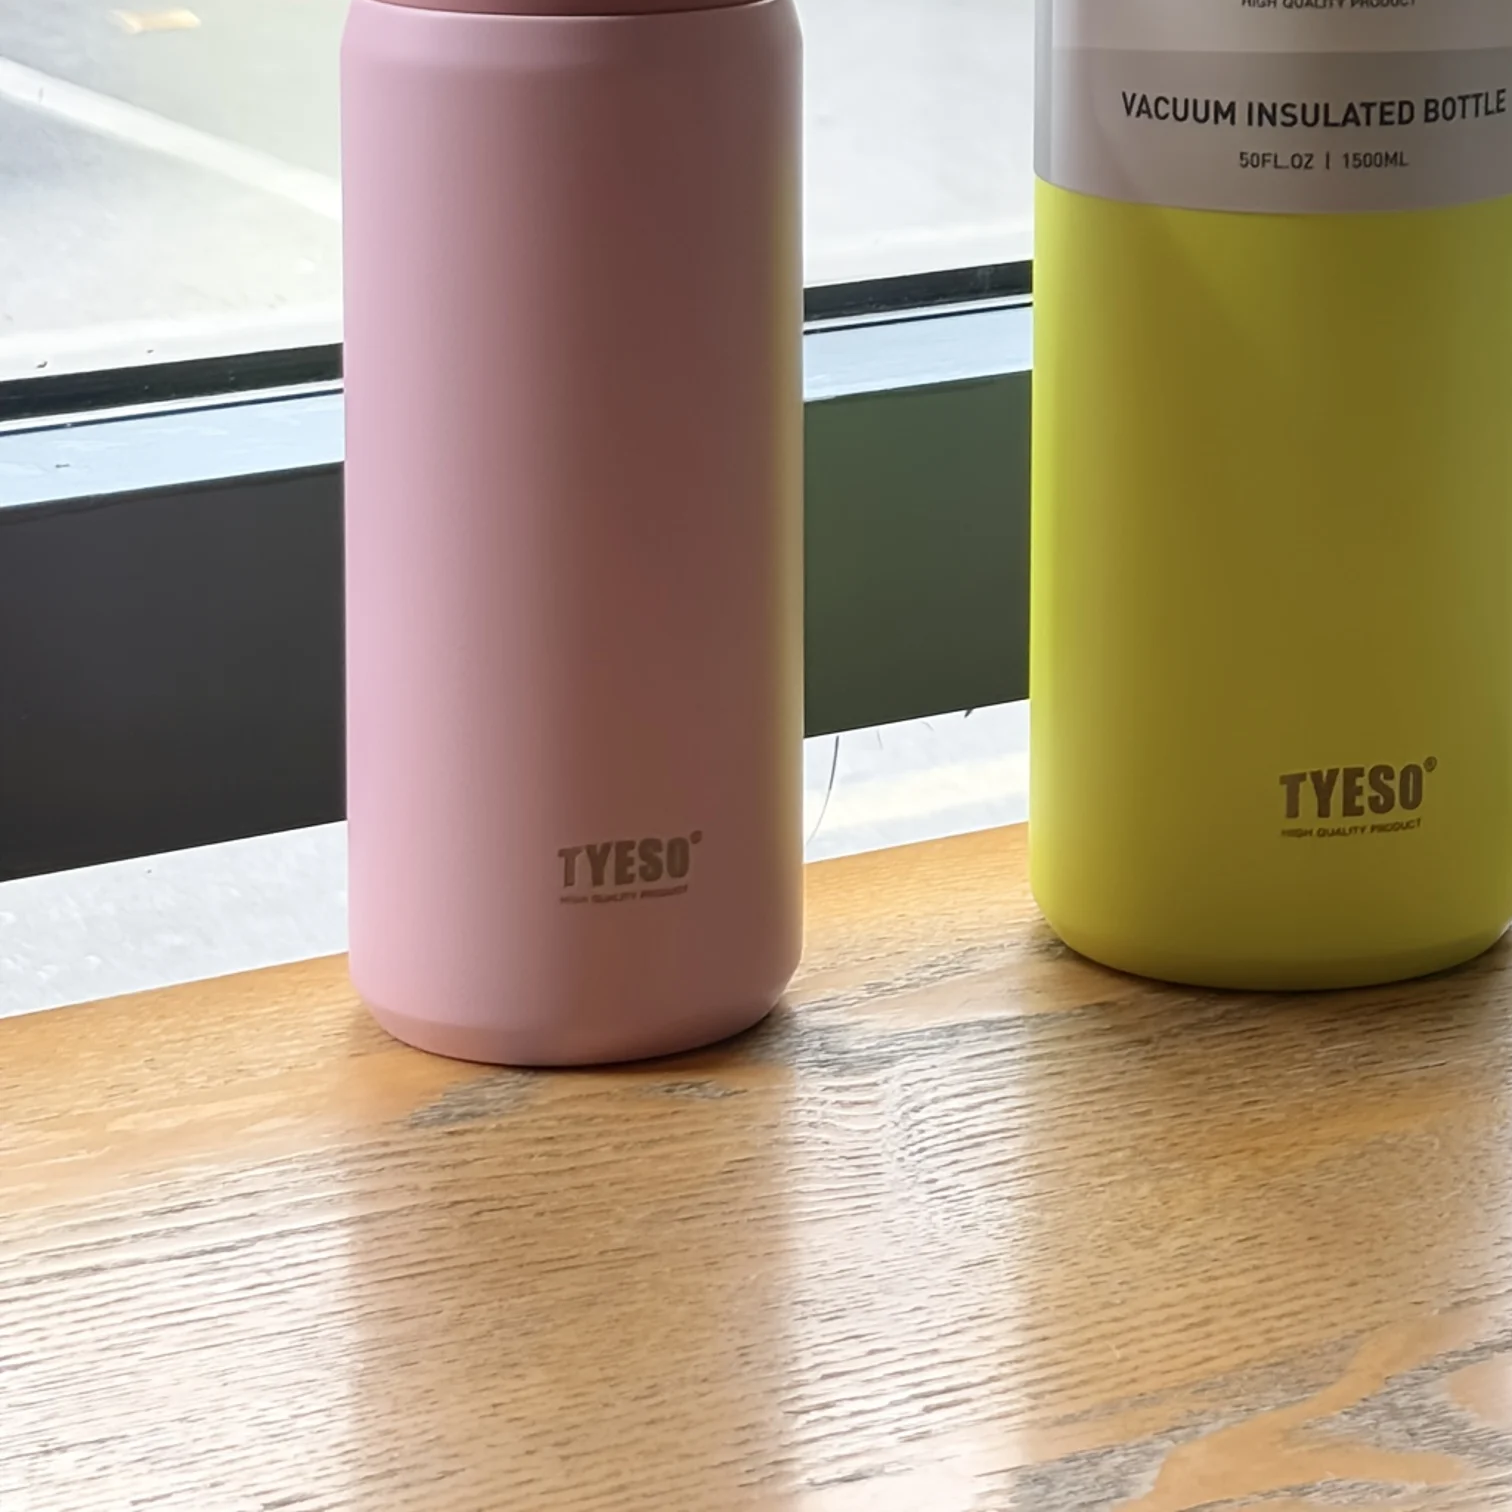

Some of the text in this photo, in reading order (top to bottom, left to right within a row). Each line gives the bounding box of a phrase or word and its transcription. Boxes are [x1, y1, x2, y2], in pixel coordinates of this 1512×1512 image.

[1121, 88, 1507, 128] VACUUM INSULATED BOTTLE
[1342, 151, 1410, 169] 1500ML
